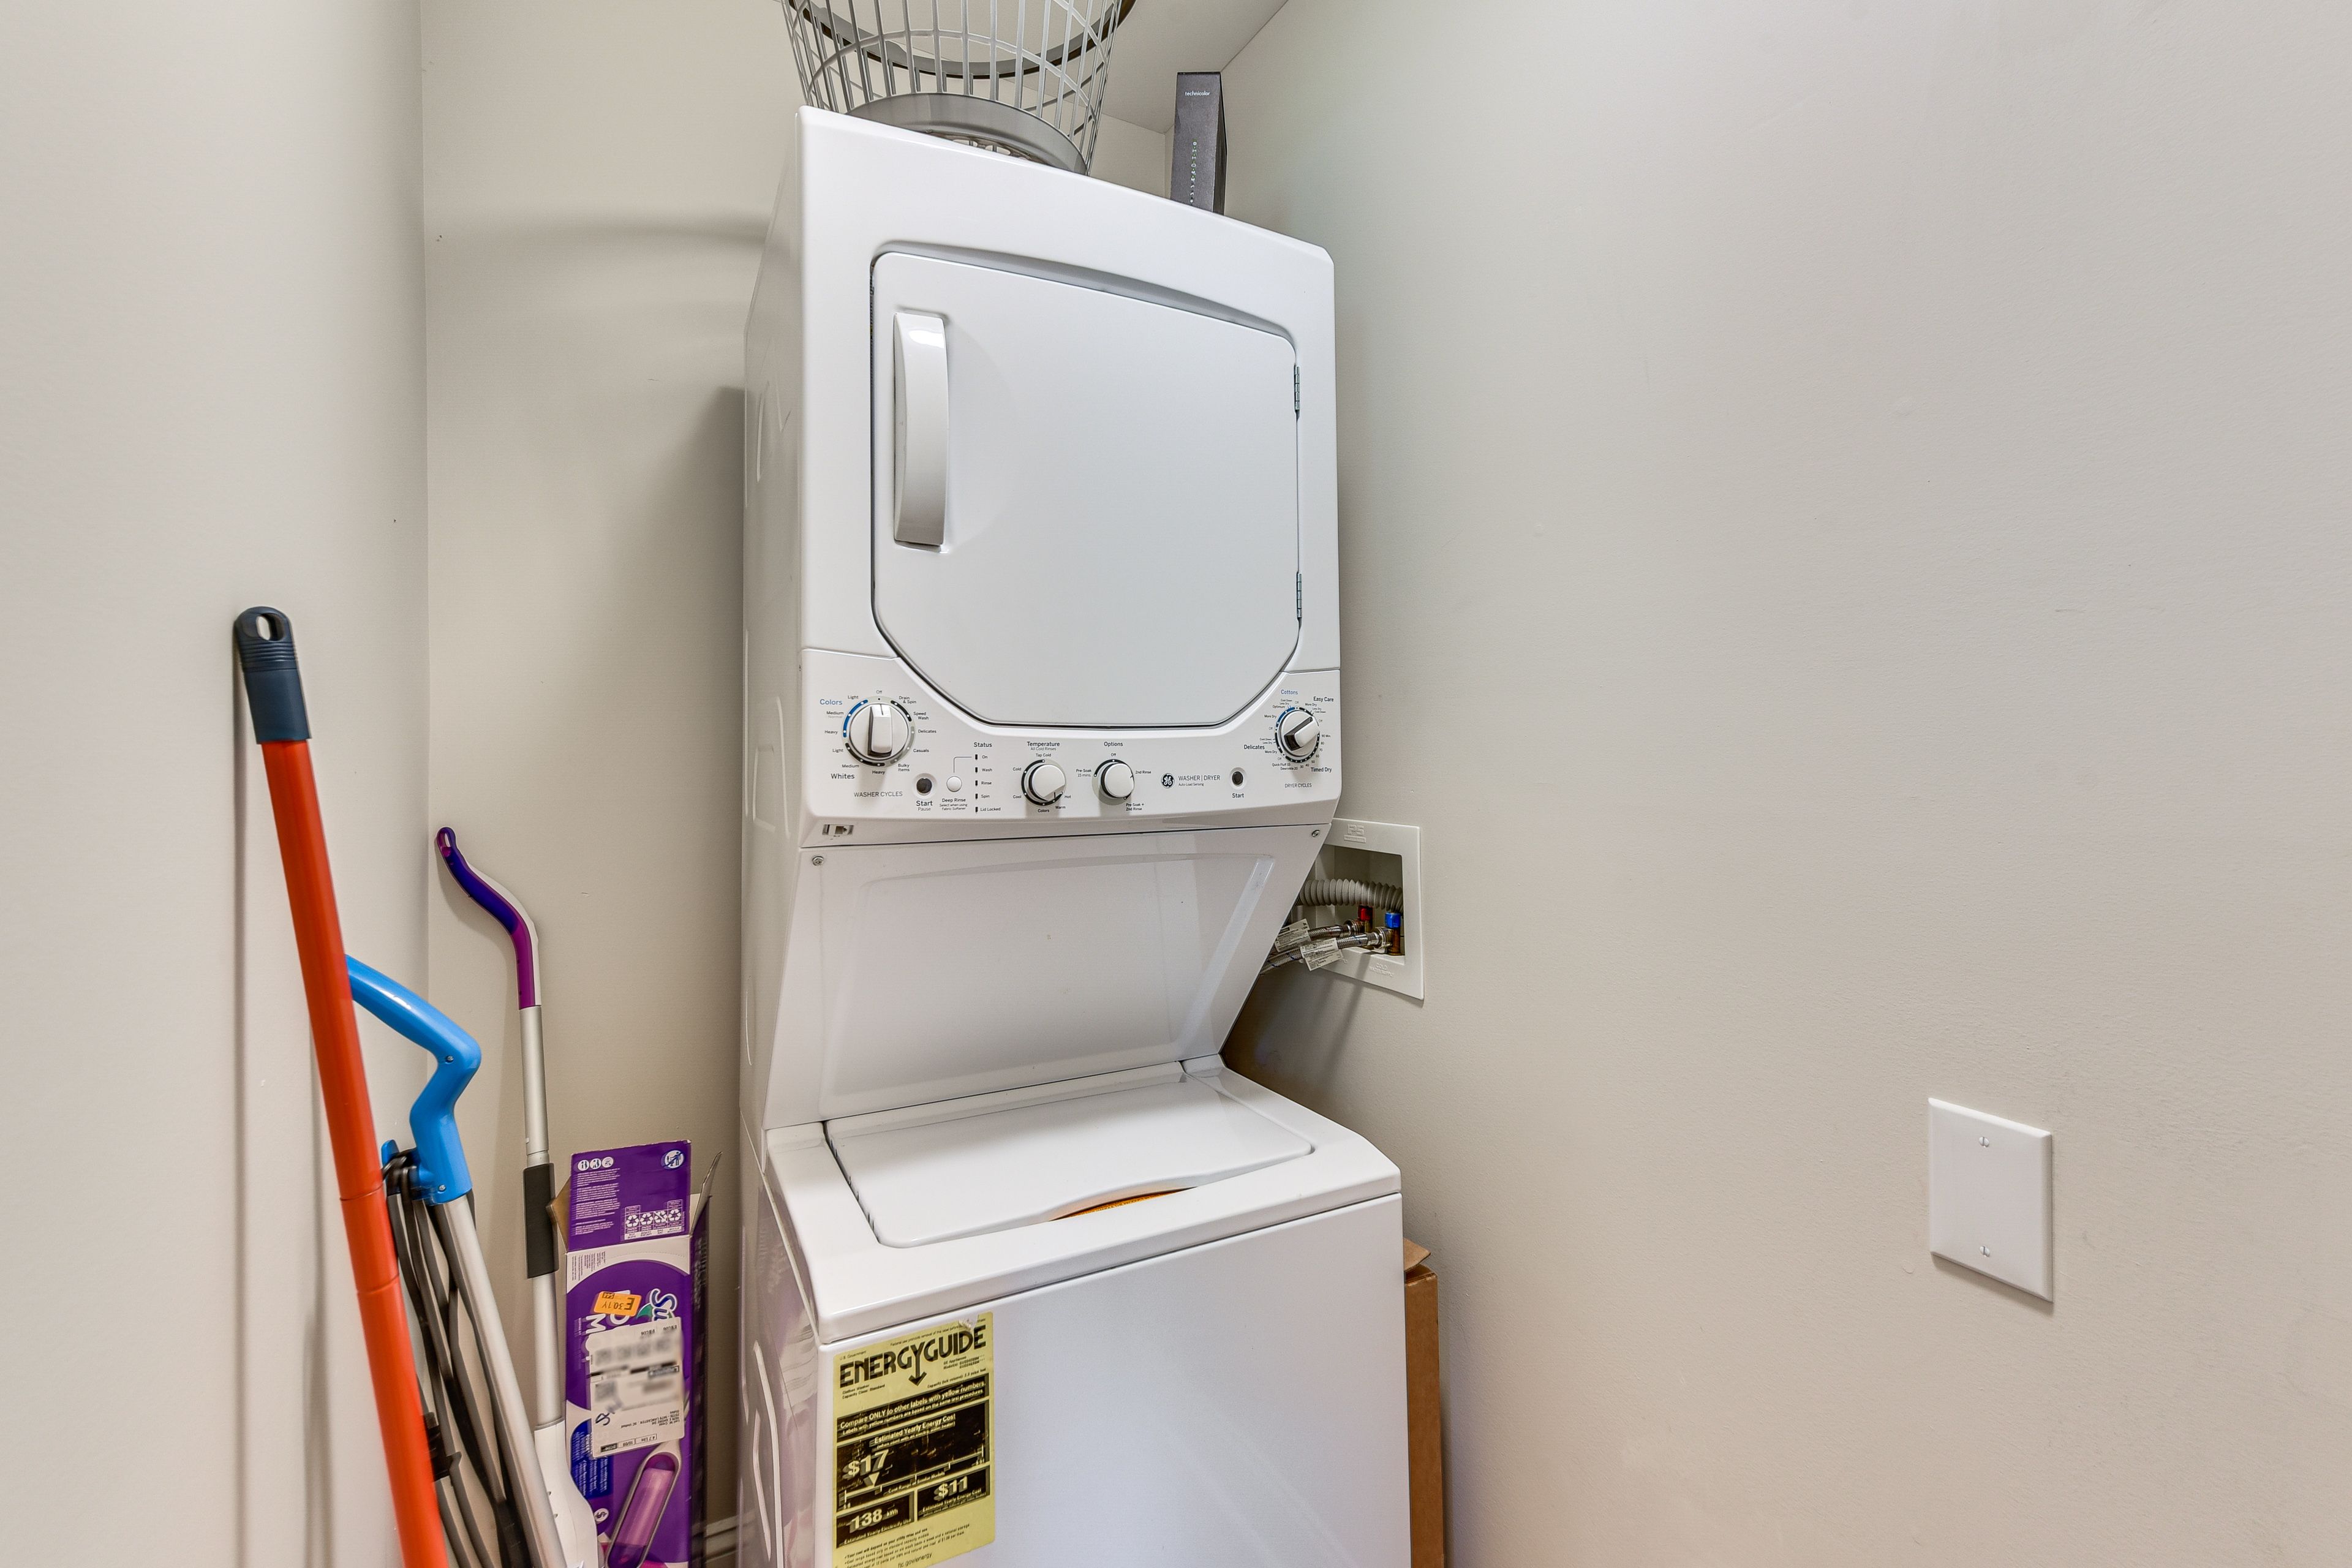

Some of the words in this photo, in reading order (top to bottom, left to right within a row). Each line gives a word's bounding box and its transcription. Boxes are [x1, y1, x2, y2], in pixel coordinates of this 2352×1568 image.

[624, 1297, 635, 1310] E
[840, 1323, 986, 1389] ENERGYGUIDE
[840, 1414, 867, 1430] Compare
[869, 1409, 886, 1420] ONLY
[894, 1402, 909, 1412] other
[911, 1396, 927, 1408] labels
[929, 1392, 940, 1402] with
[941, 1387, 959, 1400] yellow
[960, 1379, 986, 1392] numbers.
[843, 1427, 858, 1435] Labels
[869, 1419, 883, 1428] yellow
[884, 1412, 903, 1422] numbers
[875, 1429, 902, 1444] Estimated
[904, 1423, 921, 1436] Yearly
[922, 1417, 941, 1430] Energy
[943, 1412, 956, 1423] Cost
[848, 1449, 889, 1478] $17
[938, 1476, 967, 1499] $11
[922, 1501, 943, 1512] Estimated
[944, 1496, 956, 1505] Yearly
[851, 1507, 882, 1530] 138
[886, 1507, 898, 1517] kWh
[844, 1532, 866, 1545] Estimated
[867, 1528, 880, 1537] Yearly
